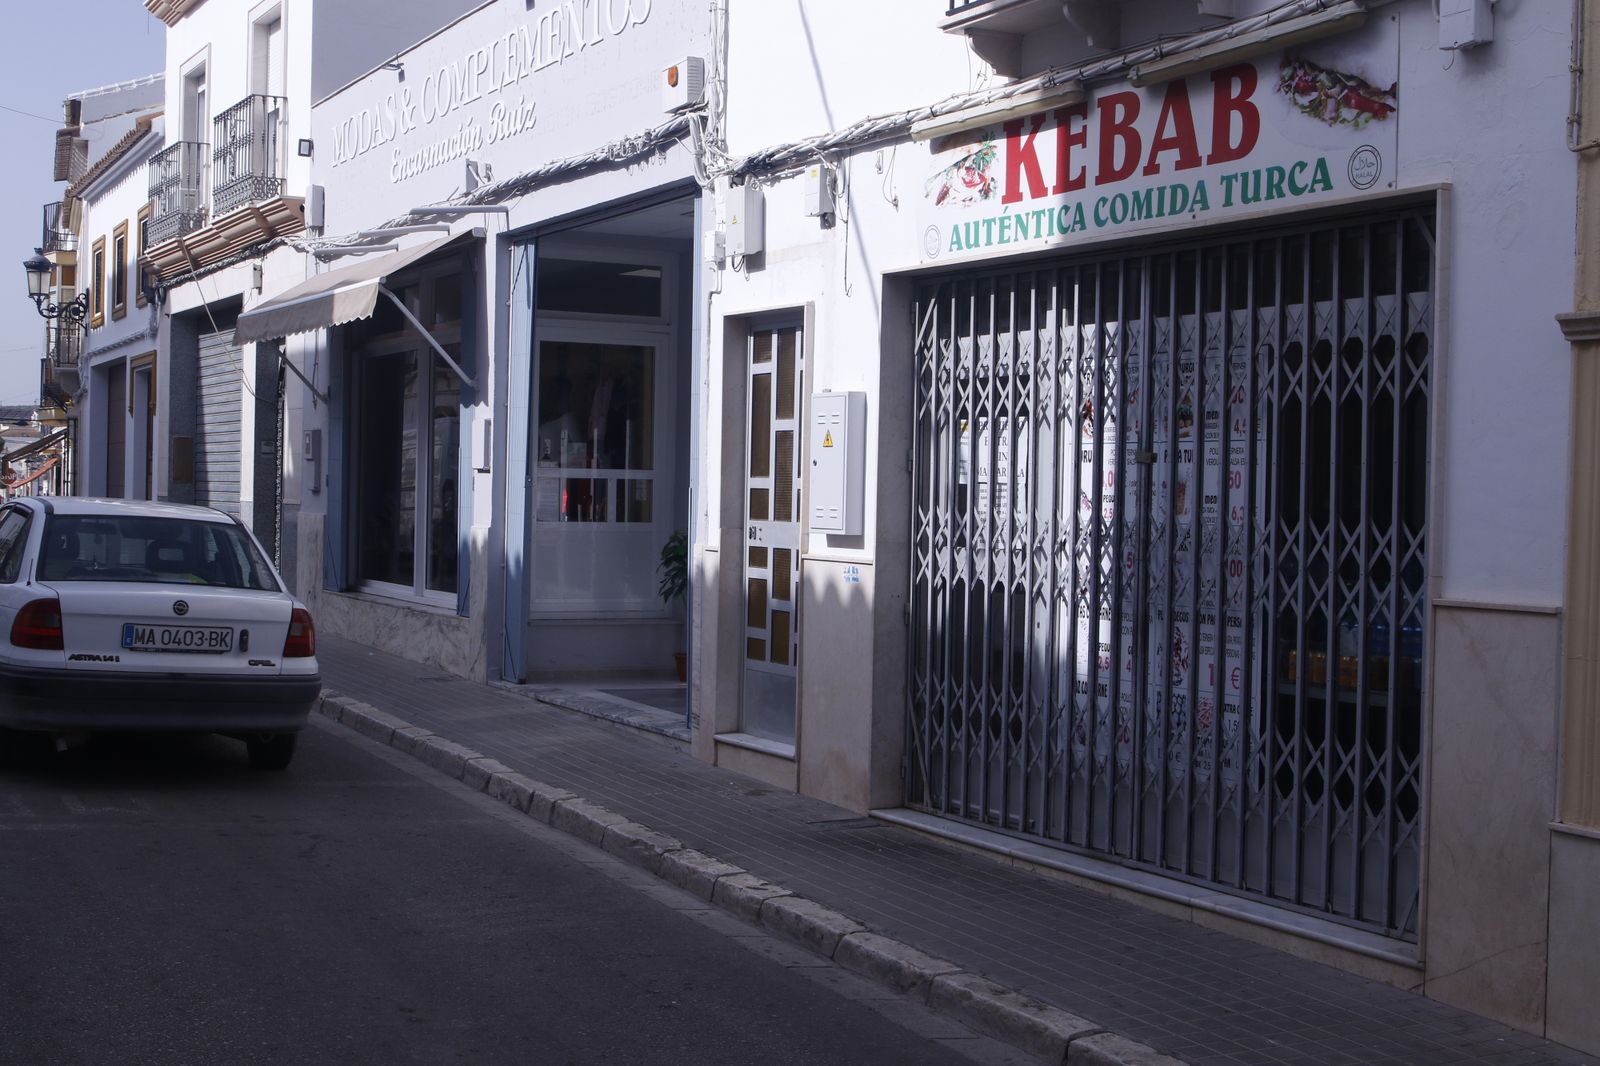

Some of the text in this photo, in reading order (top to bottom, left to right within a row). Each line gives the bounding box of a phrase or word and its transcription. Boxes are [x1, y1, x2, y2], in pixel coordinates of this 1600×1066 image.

[330, 94, 397, 168] MODAS
[399, 85, 418, 135] &
[489, 95, 537, 145] Ruiz
[1001, 62, 1262, 205] KEBAB
[948, 205, 1087, 253] AUTÉNTICA
[1093, 179, 1213, 229] COMIDA
[1220, 157, 1334, 208] TURCA
[134, 627, 156, 646] MA
